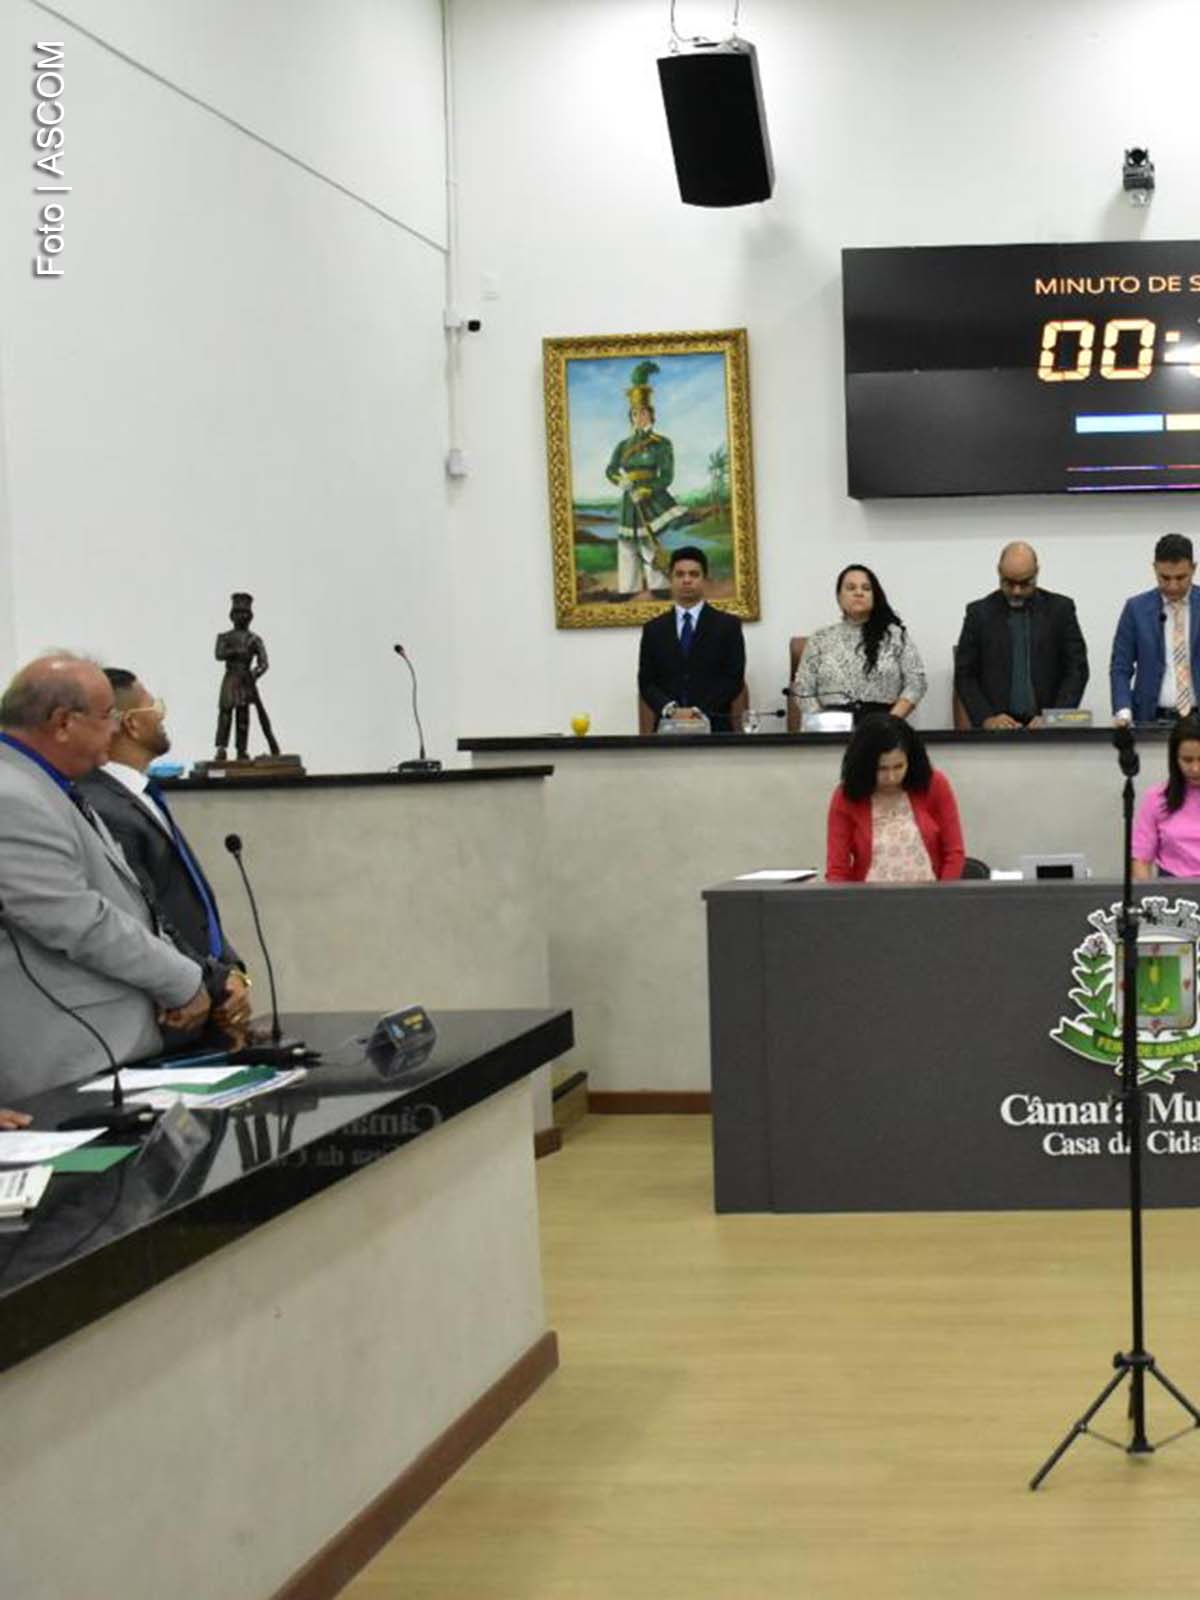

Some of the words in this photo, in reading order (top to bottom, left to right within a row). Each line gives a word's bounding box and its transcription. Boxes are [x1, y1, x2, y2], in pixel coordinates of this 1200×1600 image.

[1035, 275, 1141, 295] MINUTO
[1148, 275, 1182, 293] DE
[1043, 1131, 1101, 1156] Casa
